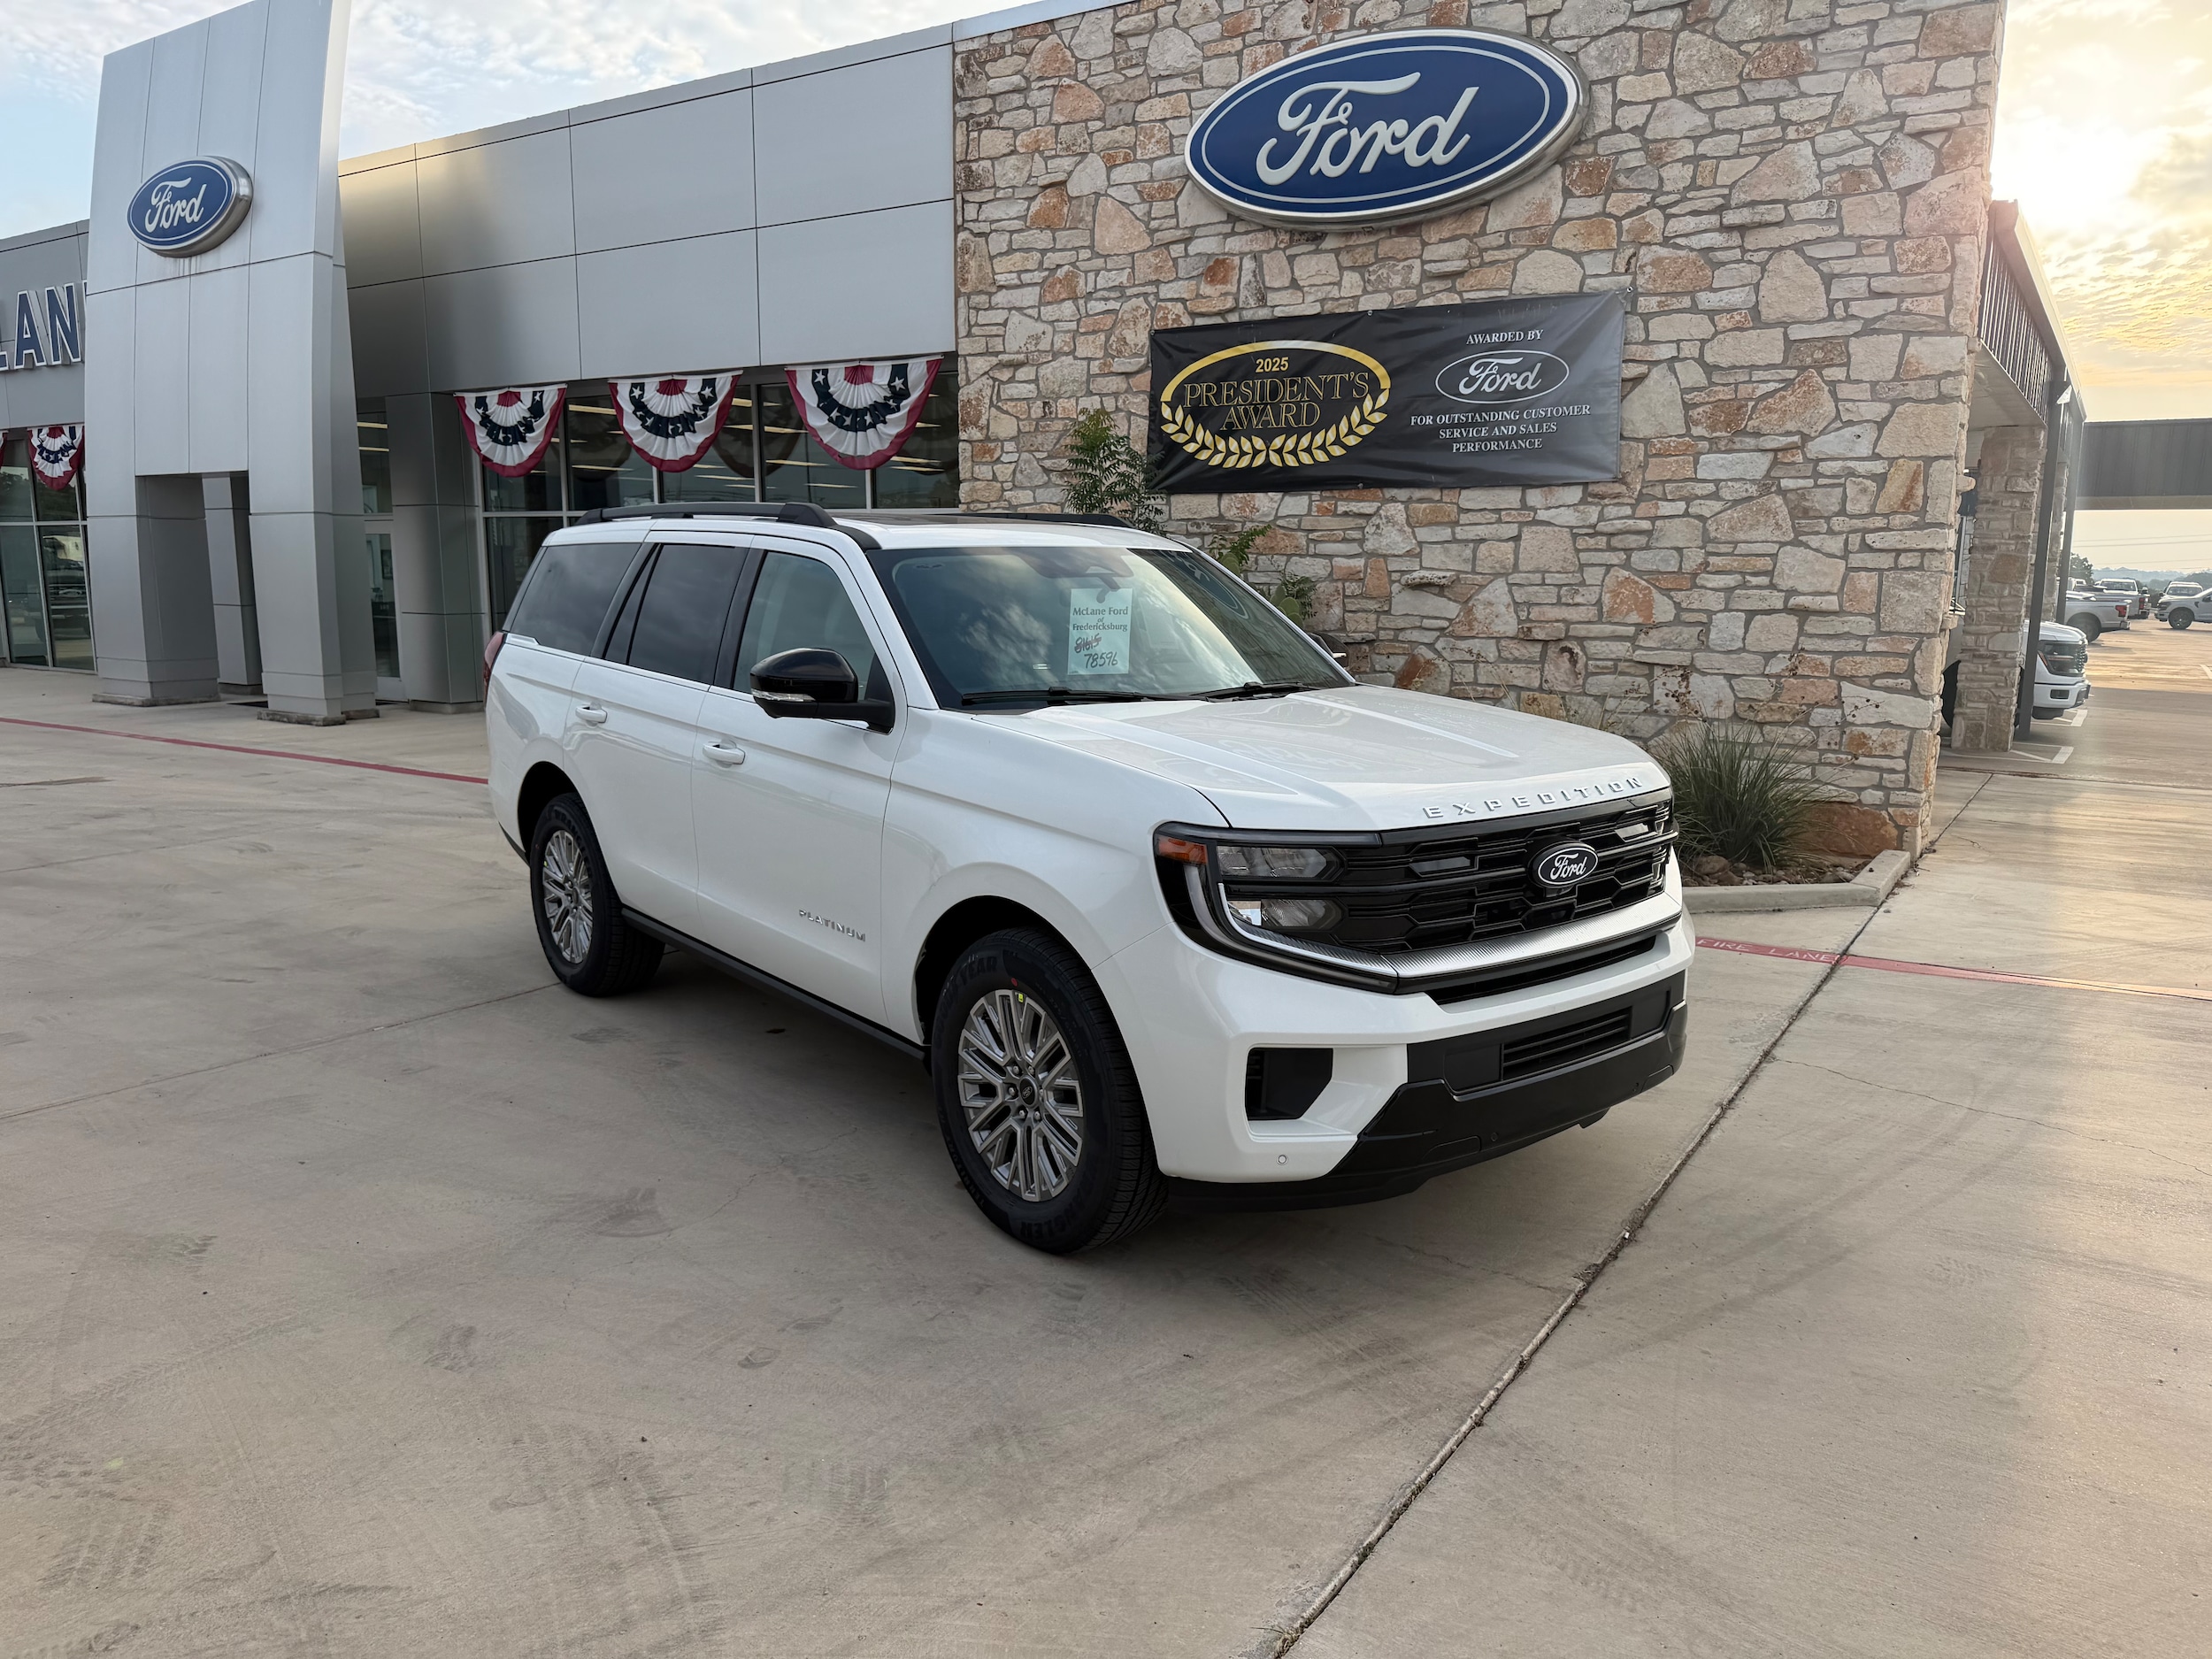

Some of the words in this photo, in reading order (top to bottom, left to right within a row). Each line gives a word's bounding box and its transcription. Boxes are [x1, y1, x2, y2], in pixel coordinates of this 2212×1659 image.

[1256, 72, 1480, 186] Ford
[144, 177, 207, 233] Ford
[0, 280, 88, 372] AN
[1466, 331, 1524, 344] AWARDED
[1527, 329, 1544, 341] BY
[1255, 357, 1289, 373] 2025
[1458, 357, 1542, 395] Ford
[1183, 372, 1369, 408] PRESIDENT'S
[1219, 402, 1321, 431] AWARD
[1410, 415, 1433, 426] FOR
[1436, 411, 1520, 425] OUTSTANDING
[1523, 404, 1591, 419] CUSTOMER
[1439, 426, 1489, 439] SERVICE
[1492, 425, 1517, 436] AND
[1519, 422, 1557, 434] SALES
[1452, 438, 1542, 453] PERFORMANCE
[1072, 607, 1106, 616] McLane
[1109, 606, 1128, 616] Ford
[1072, 622, 1128, 632] Fredericksburg
[1084, 651, 1118, 669] 78596
[1422, 777, 1643, 818] EXPEDITION
[1549, 852, 1587, 880] Ford
[799, 909, 866, 942] PLATINUM
[1696, 939, 1753, 951] FIRE
[1769, 948, 1837, 963] LANE
